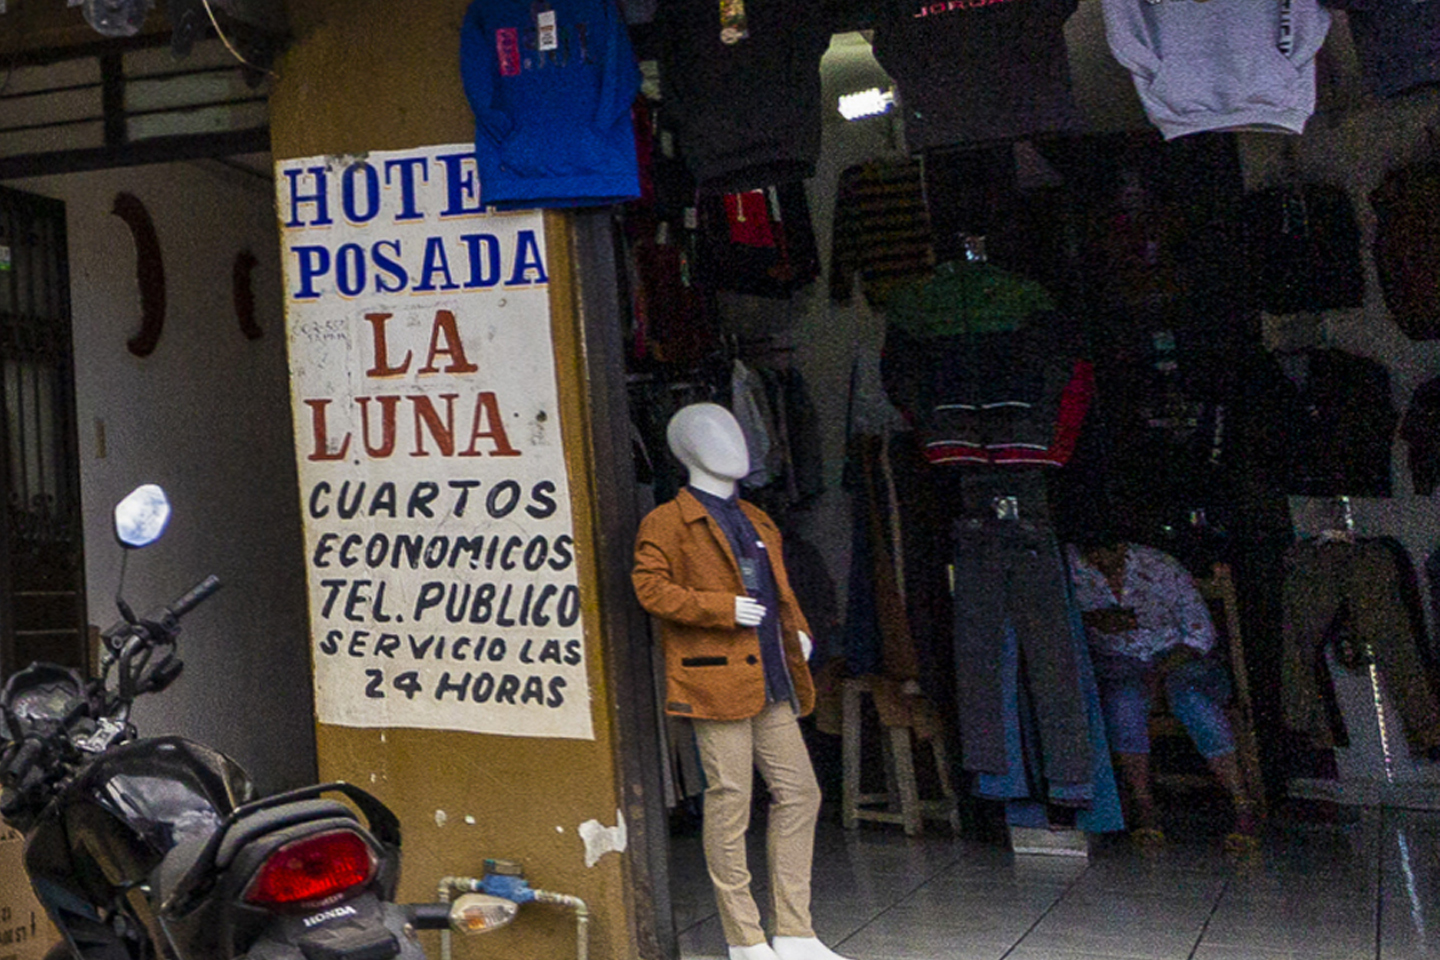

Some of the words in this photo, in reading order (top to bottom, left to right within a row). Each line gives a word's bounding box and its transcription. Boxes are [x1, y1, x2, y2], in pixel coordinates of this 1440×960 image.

[283, 152, 497, 229] HOTE
[290, 230, 549, 301] POSADA
[364, 309, 479, 378] LA
[303, 391, 522, 461] LUNA
[309, 479, 558, 519] CUARTOS
[313, 533, 574, 571] ECONOMICOS
[320, 579, 404, 623] TEL.
[413, 581, 581, 627] PUBLICO
[319, 630, 507, 662] SERVICIO
[518, 638, 582, 666] LAS
[364, 668, 423, 700] 24
[434, 672, 568, 708] HORAS
[303, 904, 357, 928] HONDA
